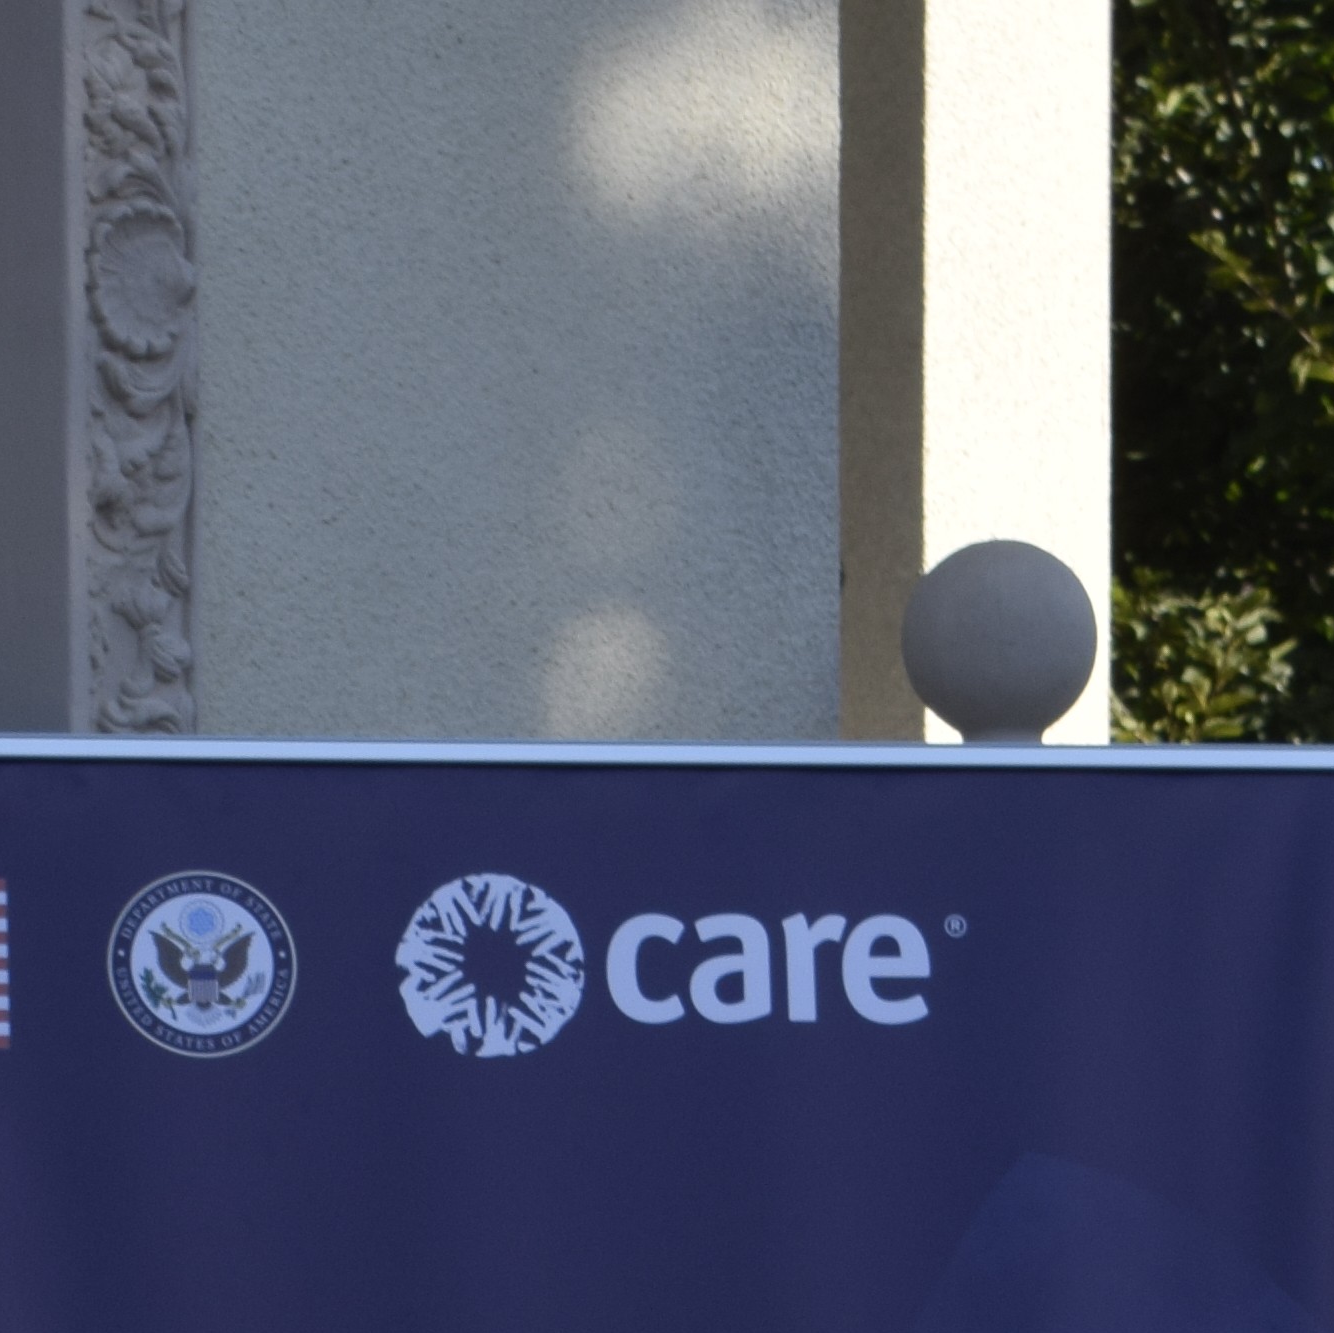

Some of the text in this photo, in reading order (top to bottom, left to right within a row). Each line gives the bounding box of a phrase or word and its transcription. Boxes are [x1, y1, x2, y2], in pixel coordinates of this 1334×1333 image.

[120, 878, 283, 940] DEPARTMENT OF STATE
[117, 966, 290, 1051] UNITED STATES OF AMERICA
[606, 912, 931, 1025] care
